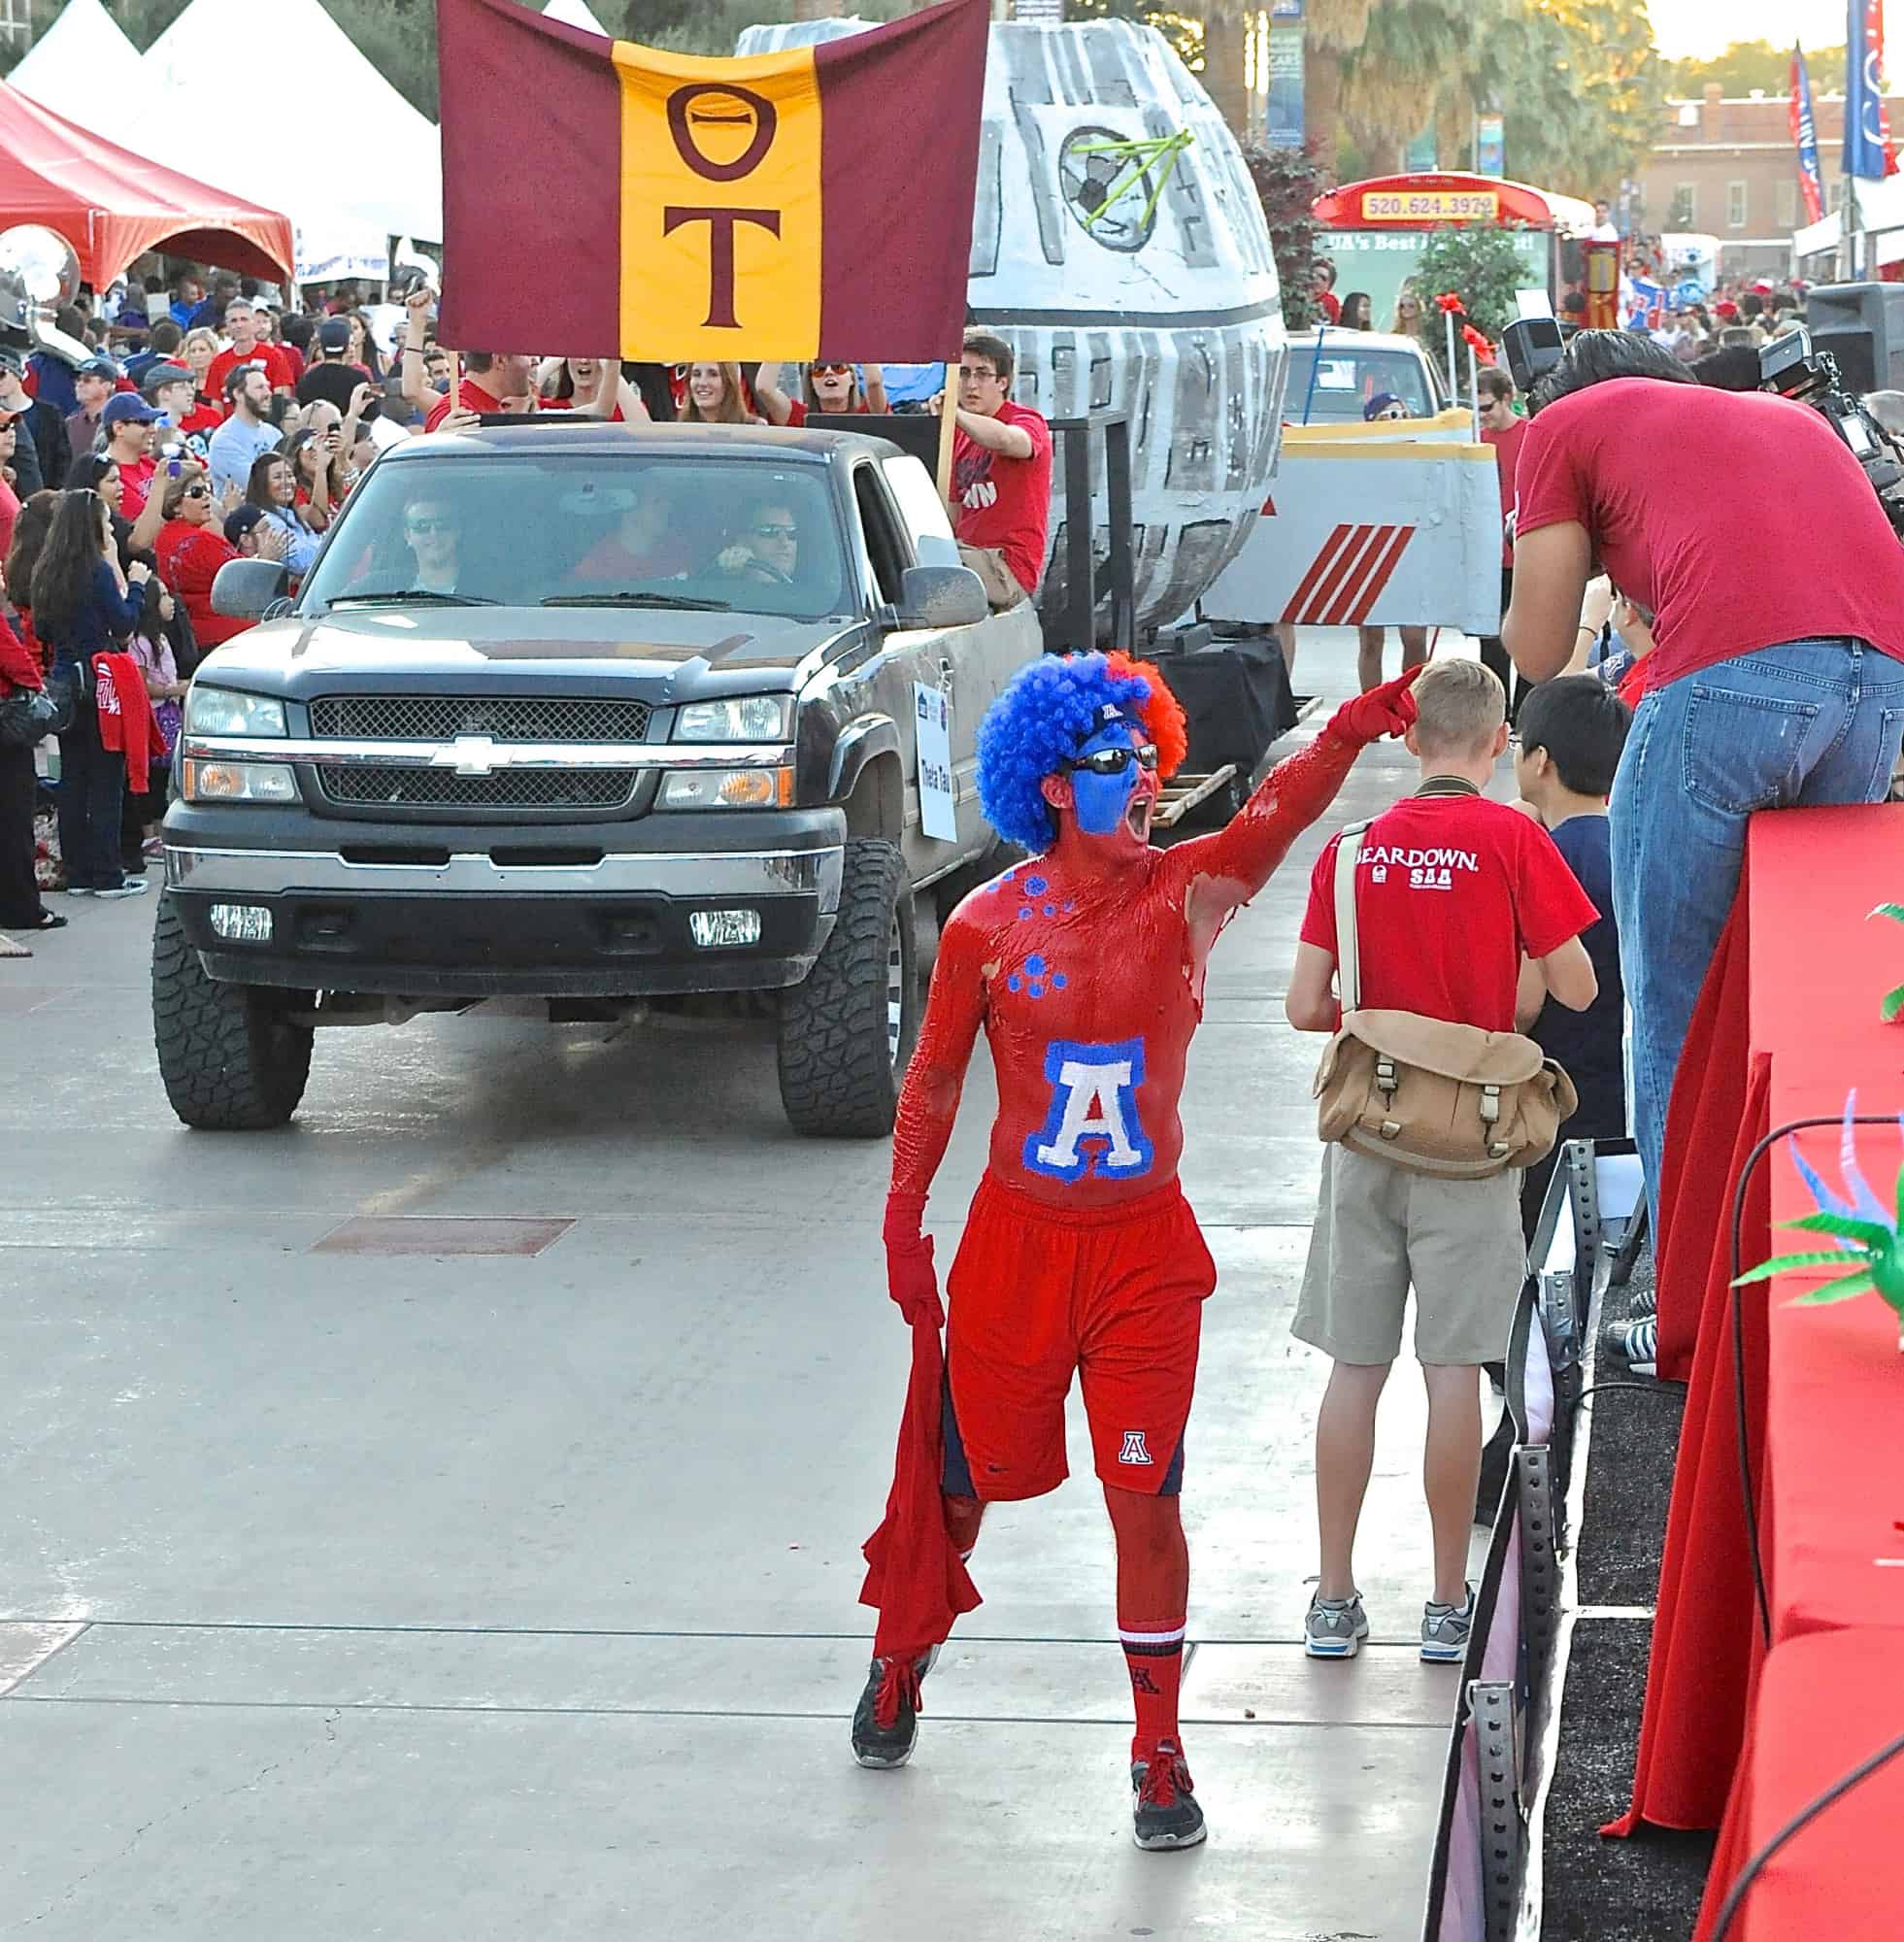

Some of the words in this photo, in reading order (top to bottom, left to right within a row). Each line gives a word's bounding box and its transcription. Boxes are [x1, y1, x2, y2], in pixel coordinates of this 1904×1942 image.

[1369, 197, 1493, 215] 520.624.3972
[1375, 233, 1417, 251] Best
[1410, 867, 1453, 885] SAA
[1033, 1056, 1146, 1170] A
[1119, 1430, 1151, 1464] A
